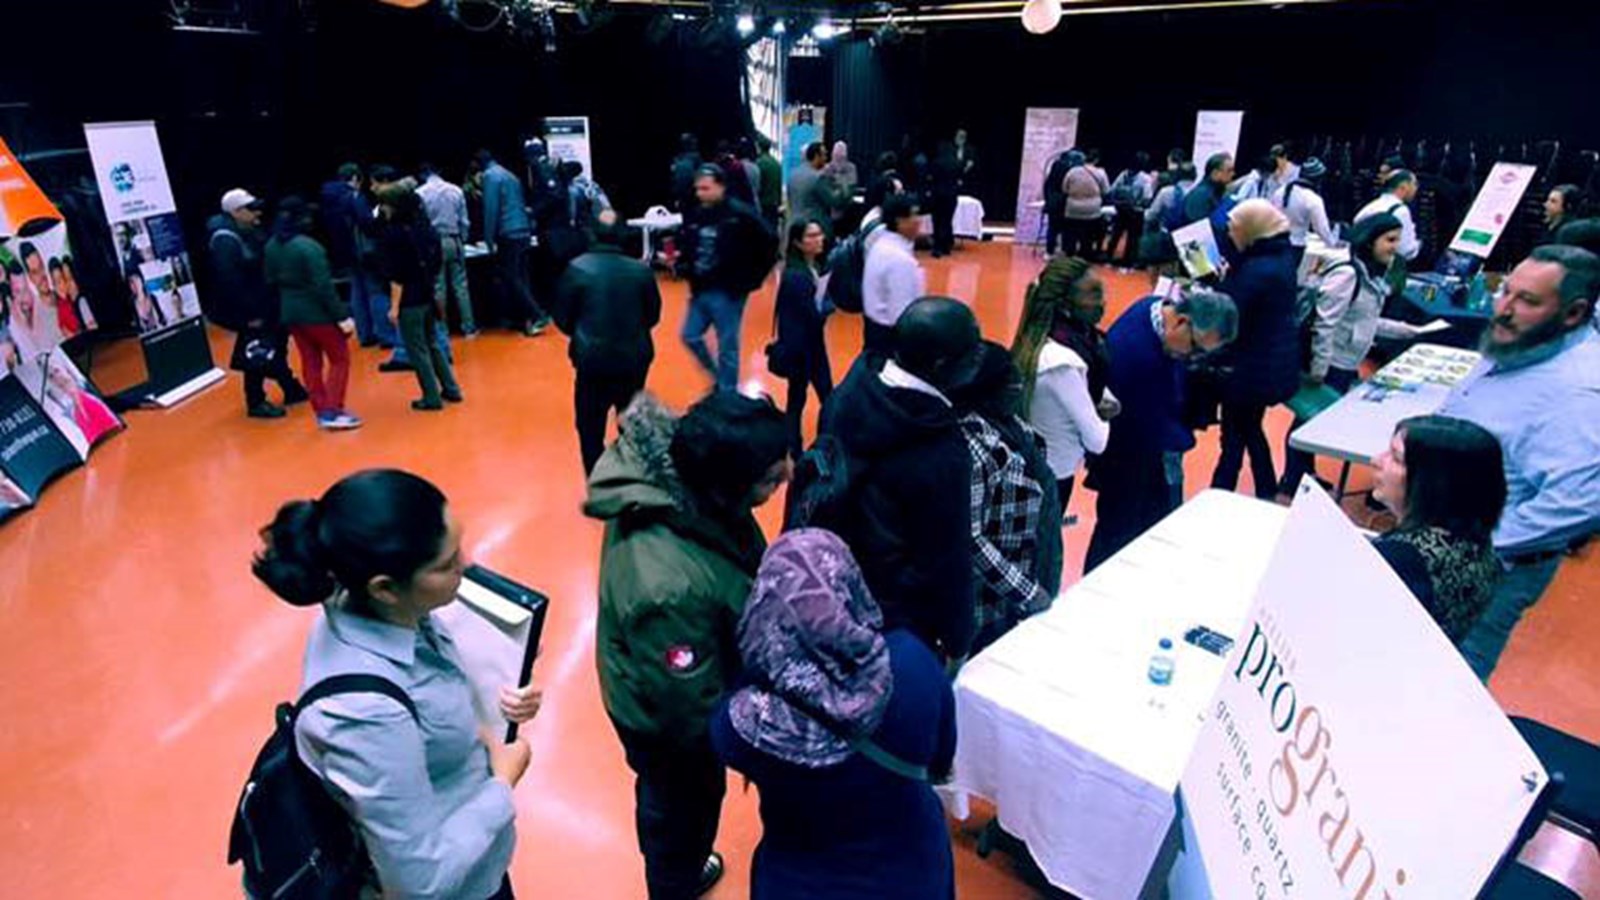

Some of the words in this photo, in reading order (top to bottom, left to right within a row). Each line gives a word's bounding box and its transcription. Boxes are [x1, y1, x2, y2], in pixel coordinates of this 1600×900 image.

[1215, 700, 1252, 781] granite
[1256, 800, 1294, 896] quartz
[1217, 762, 1252, 855] surface
